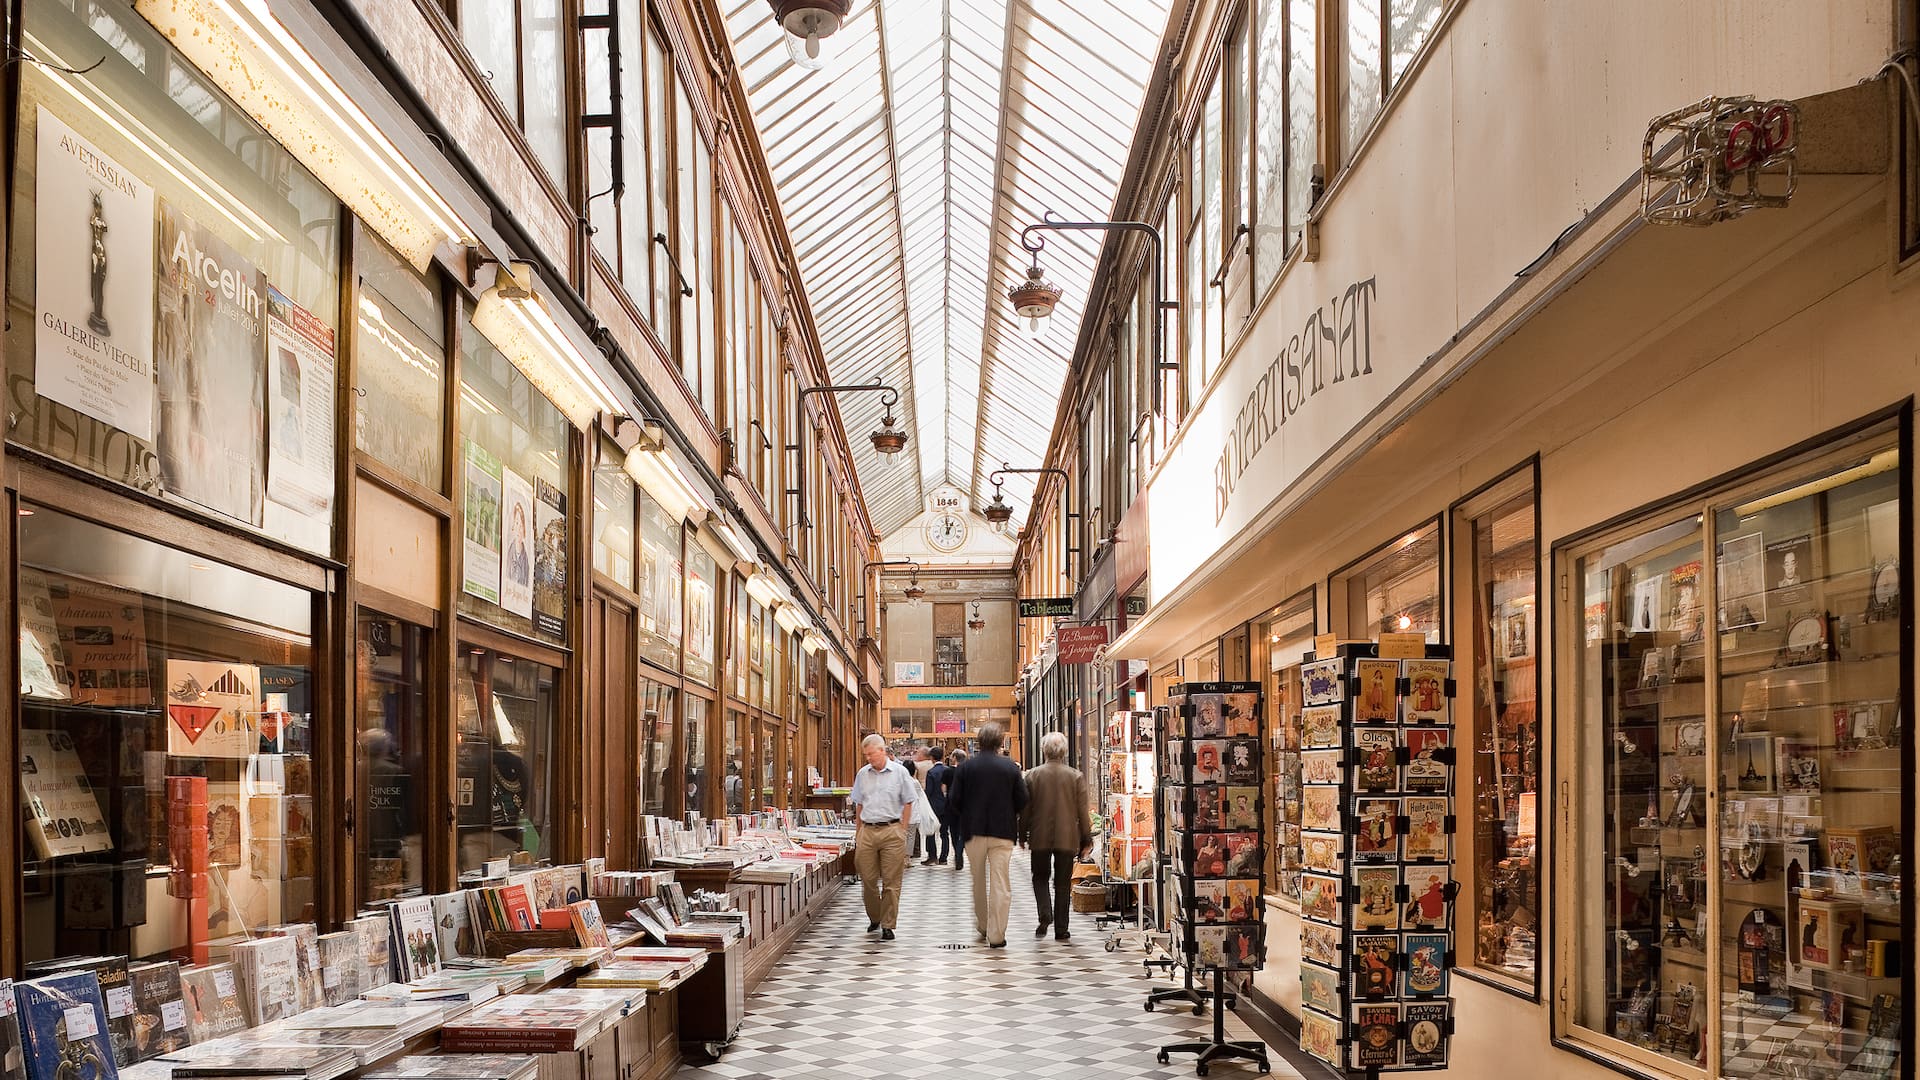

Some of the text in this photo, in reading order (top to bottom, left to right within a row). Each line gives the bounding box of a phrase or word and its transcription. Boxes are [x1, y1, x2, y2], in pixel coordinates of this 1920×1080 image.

[60, 134, 137, 199] AVETISSIAN
[172, 231, 259, 319] Arcelin
[204, 290, 216, 307] 26
[240, 313, 259, 337] 2010
[43, 312, 147, 377] GALERIE VIECELI
[1214, 275, 1376, 528] BIOTARTISANAT
[937, 498, 958, 506] 1846
[1021, 602, 1072, 616] Tableaux
[1070, 629, 1104, 642] Boudoir
[263, 676, 295, 686] KLASEN
[1362, 732, 1388, 742] Olida
[370, 786, 401, 795] HINESE
[370, 796, 391, 809] SILK
[98, 969, 127, 984] Saladin
[1411, 1006, 1442, 1015] SAVON
[1361, 1013, 1396, 1027] LE CHAT
